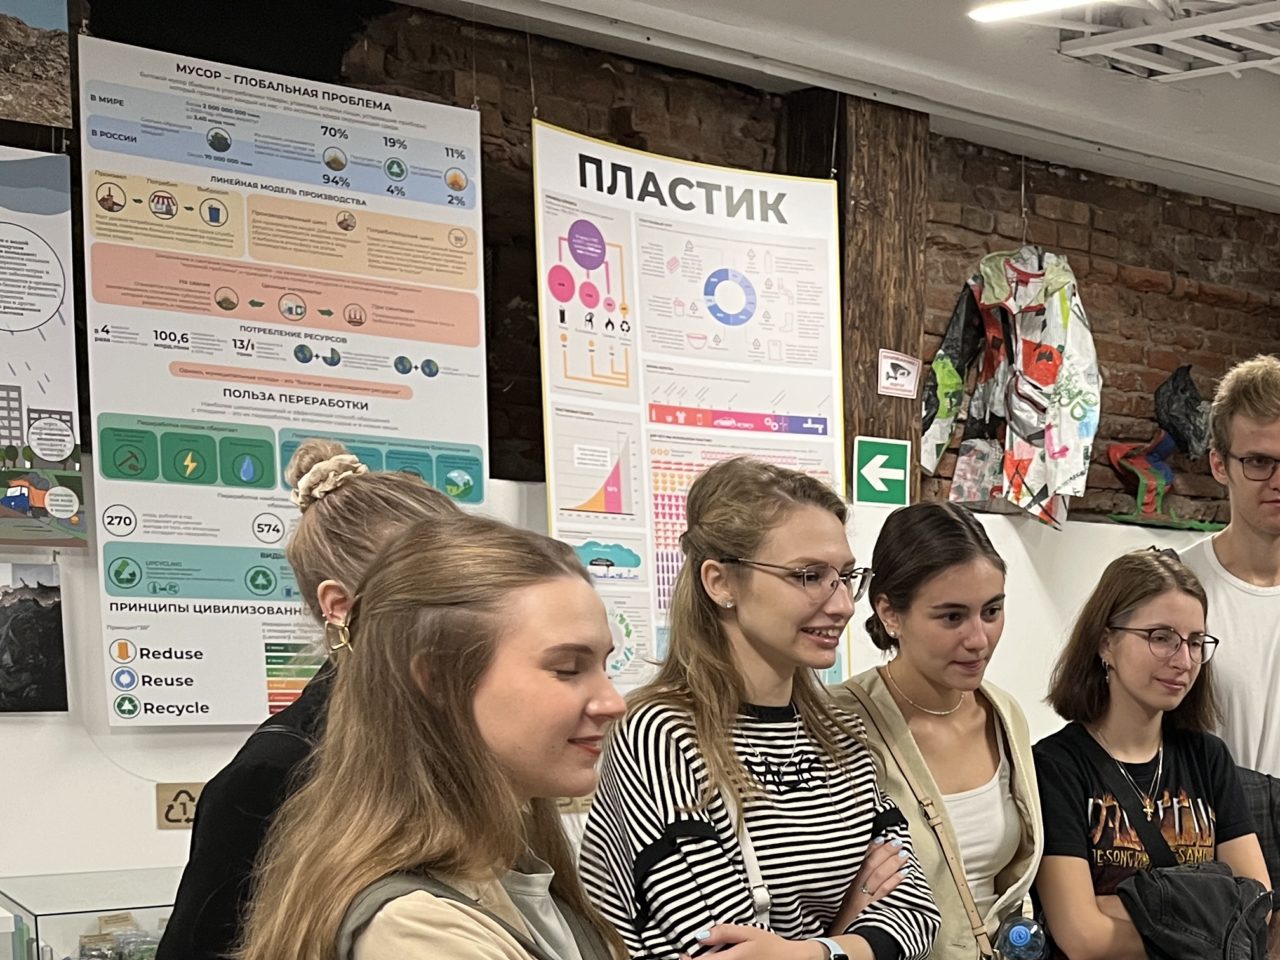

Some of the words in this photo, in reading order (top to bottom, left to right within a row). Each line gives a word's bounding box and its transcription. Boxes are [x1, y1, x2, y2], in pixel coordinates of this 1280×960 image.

[176, 63, 222, 80] МУСОР
[233, 74, 318, 99] ГЛОБАЛЬНАЯ
[322, 91, 392, 112] ПРОБЛЕМА
[98, 95, 125, 107] МИРЕ
[91, 129, 98, 137] В
[100, 130, 137, 144] РОССИИ
[320, 125, 349, 140] 70%
[382, 136, 408, 150] 19%
[444, 147, 466, 160] 11%
[322, 174, 351, 188] 94%
[210, 176, 258, 189] ЛИНЕЙНАЯ
[260, 183, 297, 196] МОДЕЛЬ
[299, 190, 367, 206] ПРОИЗВОДСТВА
[386, 185, 406, 197] 4%
[578, 153, 788, 225] ПЛАСТИК
[447, 195, 466, 207] 2%
[101, 325, 110, 335] 4
[153, 330, 189, 344] 100,6
[240, 325, 302, 339] ПОТРЕБЛЕНИЕ
[304, 332, 347, 344] РЕСУРСОВ
[223, 388, 276, 402] ПОЛЬЗА
[279, 393, 369, 411] ПЕРЕРАБОТКИ
[106, 515, 132, 526] 270
[257, 523, 280, 534] 574
[110, 602, 190, 614] ПРИНЦИПЫ
[139, 647, 203, 660] Reduse
[141, 675, 194, 687] Reuse
[143, 701, 210, 716] Recycle
